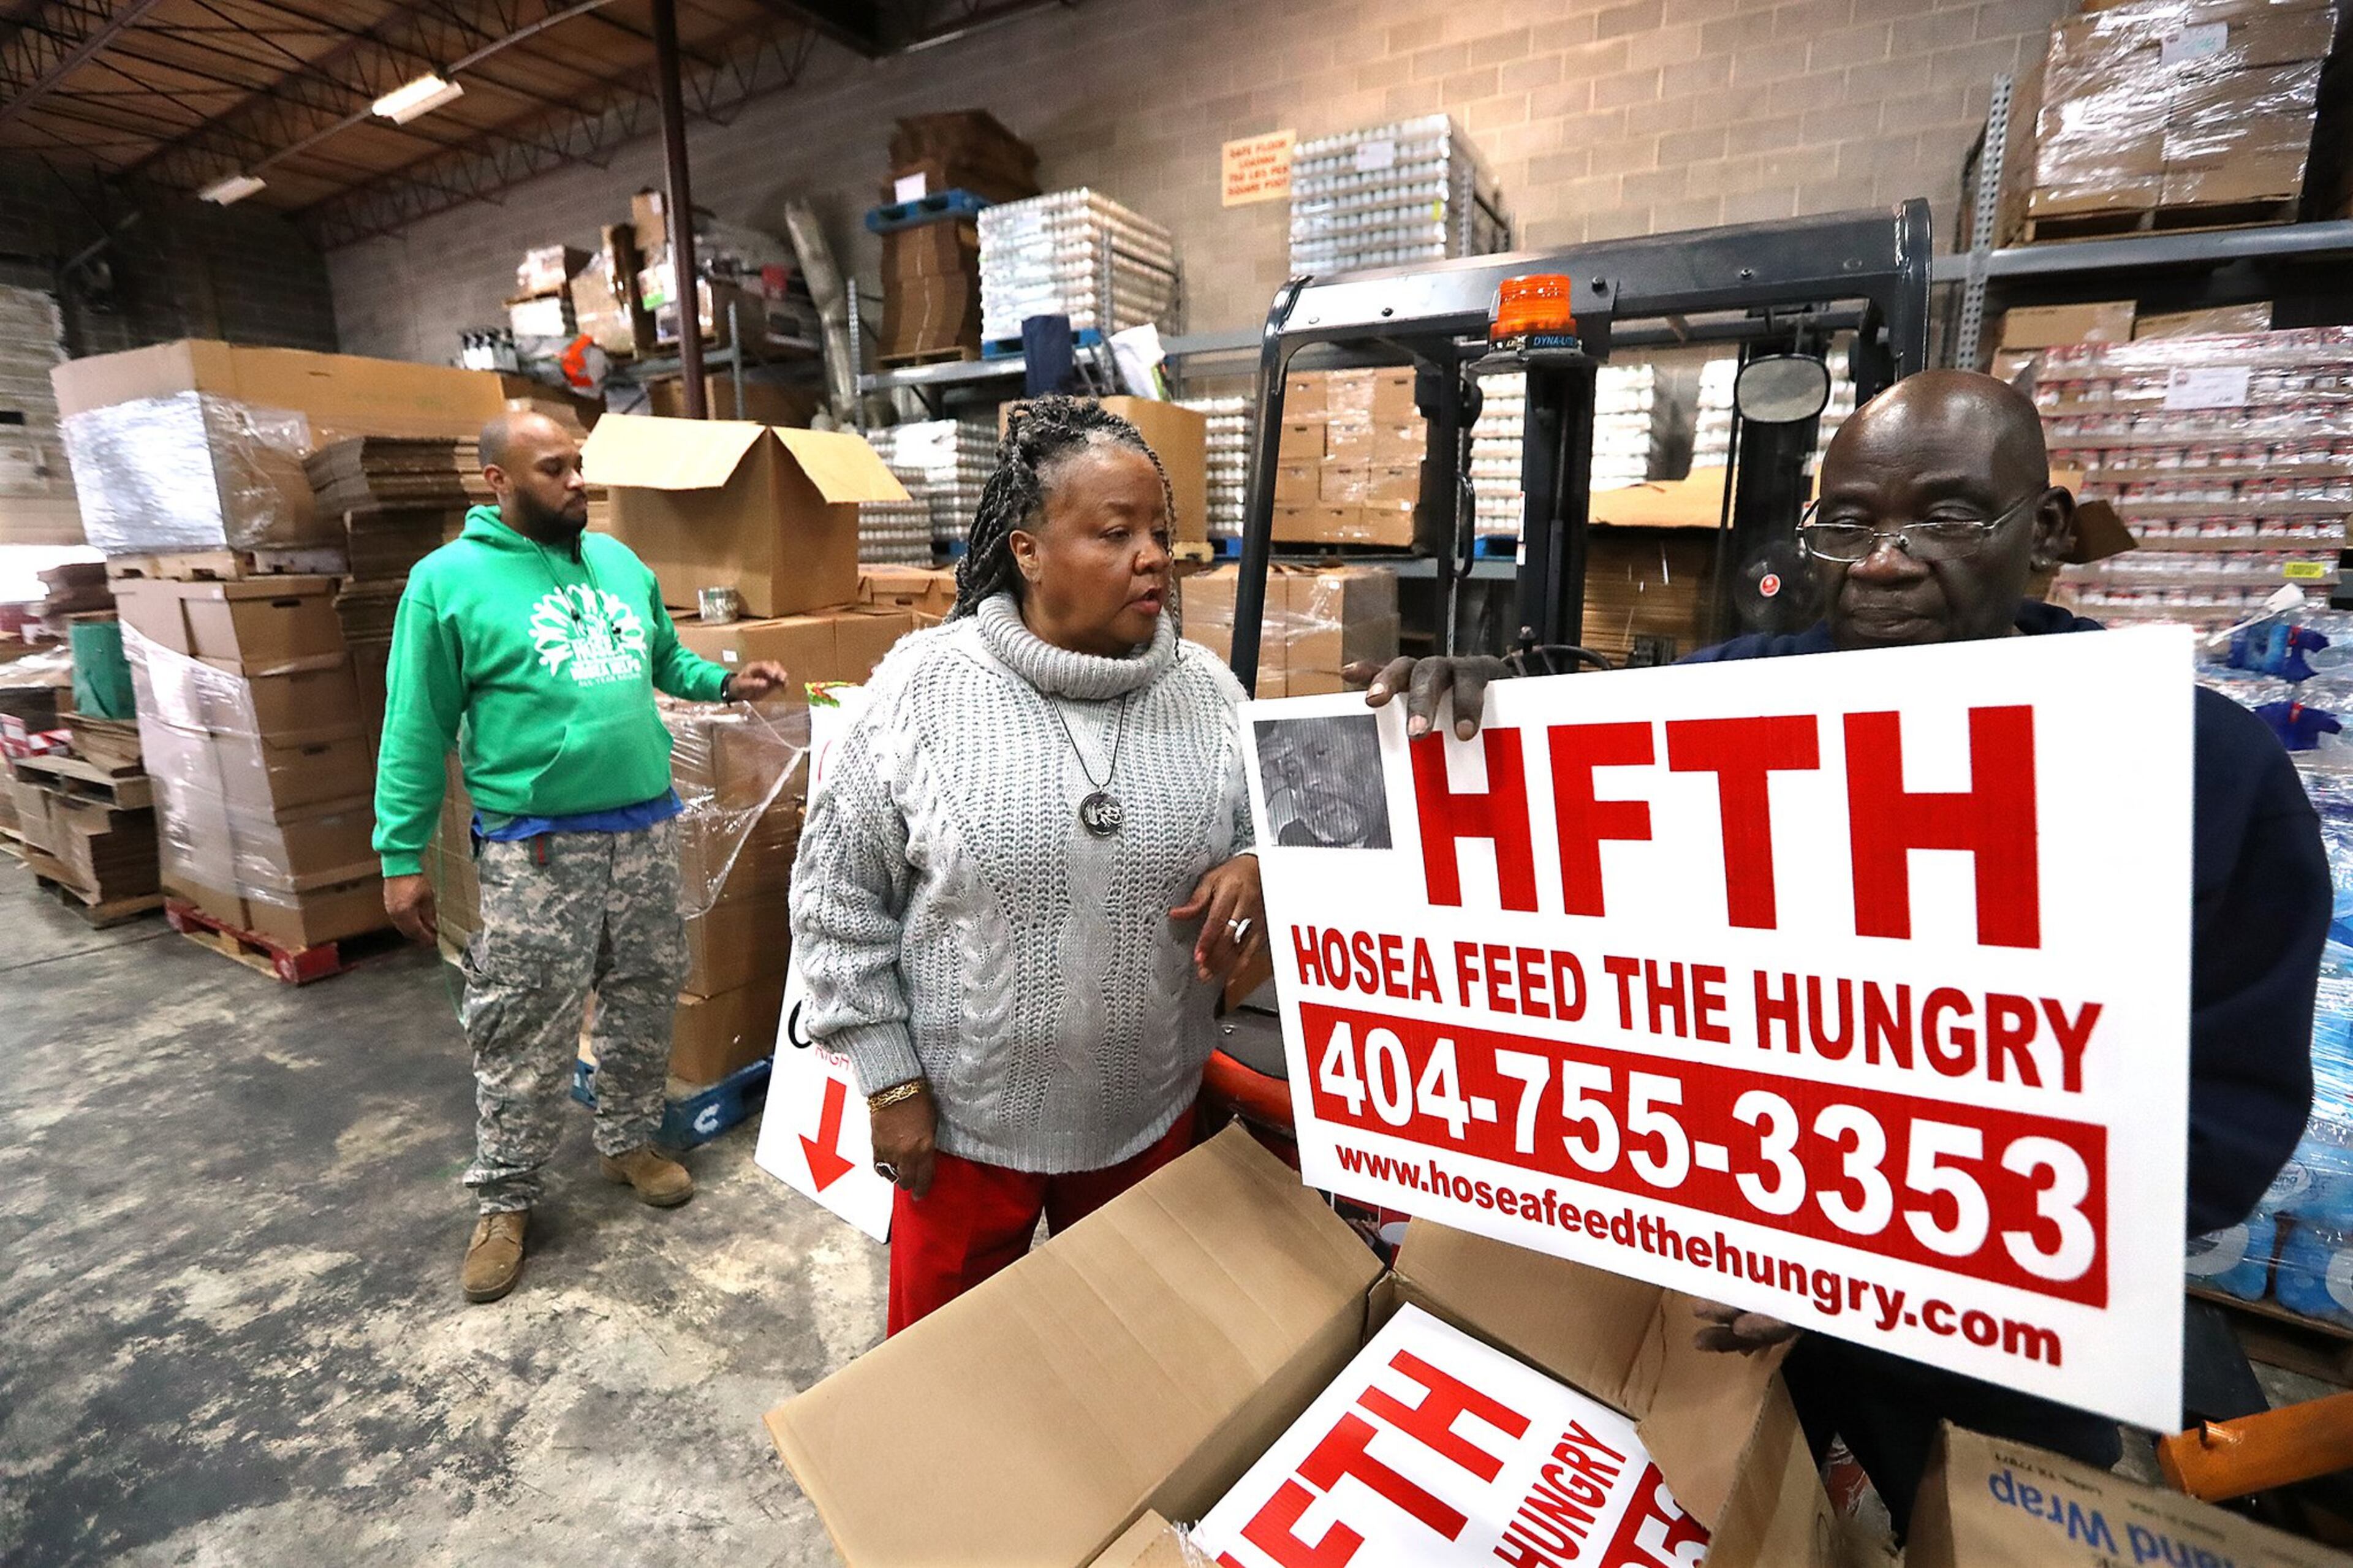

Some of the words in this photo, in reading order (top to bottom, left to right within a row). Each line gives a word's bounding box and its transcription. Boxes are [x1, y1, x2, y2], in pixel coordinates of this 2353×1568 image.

[1410, 705, 2041, 949] HFTH
[1291, 925, 1442, 1003] HOSEA
[1454, 941, 1587, 1022] FEED
[1604, 955, 1730, 1044] THE
[1754, 969, 2104, 1093] HUNGRY
[1319, 1021, 2097, 1282] 404-755-3353
[1335, 1144, 2062, 1367] www.hoseafeedthehungry.com
[1216, 1349, 1531, 1568] FTH
[1988, 1470, 2120, 1556] Wrap
